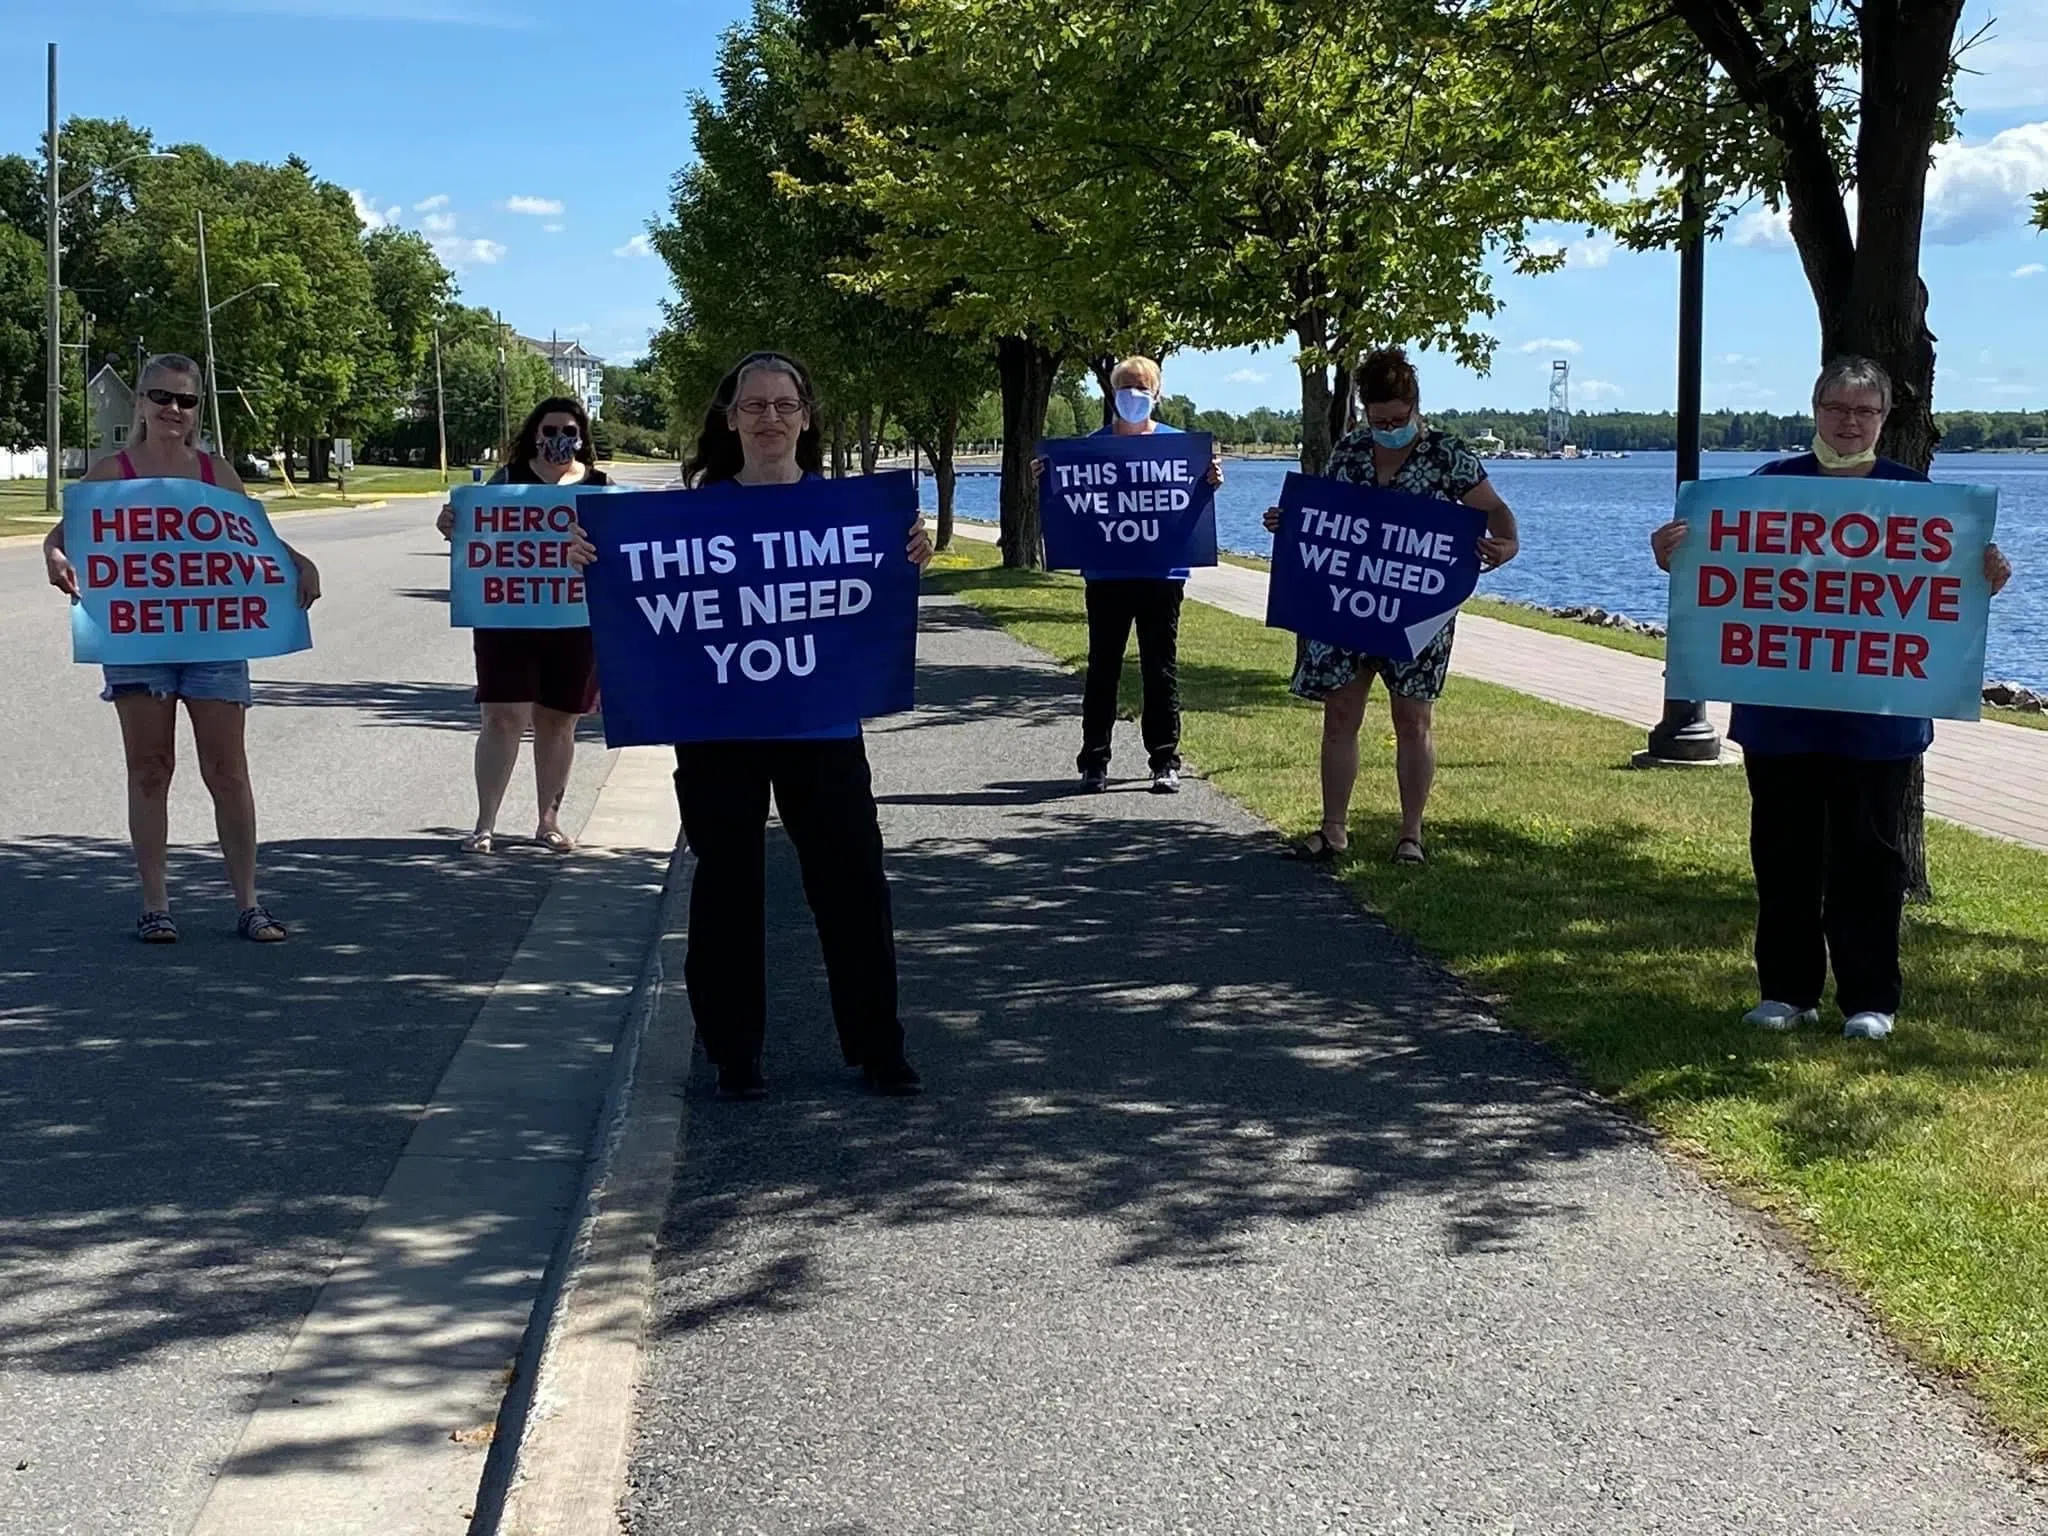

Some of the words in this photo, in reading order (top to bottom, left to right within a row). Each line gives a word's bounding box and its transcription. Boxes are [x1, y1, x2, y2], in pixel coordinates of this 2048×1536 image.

[1055, 462, 1117, 488] THIS
[1125, 459, 1195, 485] TIME,
[474, 505, 577, 533] HERO
[1064, 492, 1109, 514] WE
[1118, 488, 1190, 513] NEED
[92, 506, 259, 547] HEROES
[1098, 519, 1159, 543] YOU
[1299, 506, 1370, 549] THIS
[1381, 522, 1458, 567] TIME,
[1710, 509, 1954, 563] HEROES
[87, 552, 286, 588] DESERVE
[467, 541, 573, 569] DESE
[620, 535, 737, 582] THIS
[752, 525, 885, 569] TIME,
[1298, 542, 1347, 578] WE
[1357, 555, 1446, 597] NEED
[483, 576, 585, 604] BETTE
[635, 591, 724, 635] WE
[738, 578, 872, 627] NEED
[1329, 584, 1401, 624] YOU
[1697, 565, 1962, 622] DESERVE
[109, 595, 271, 635] BETTER
[703, 634, 817, 684] YOU
[1721, 623, 1929, 680] BETTER
